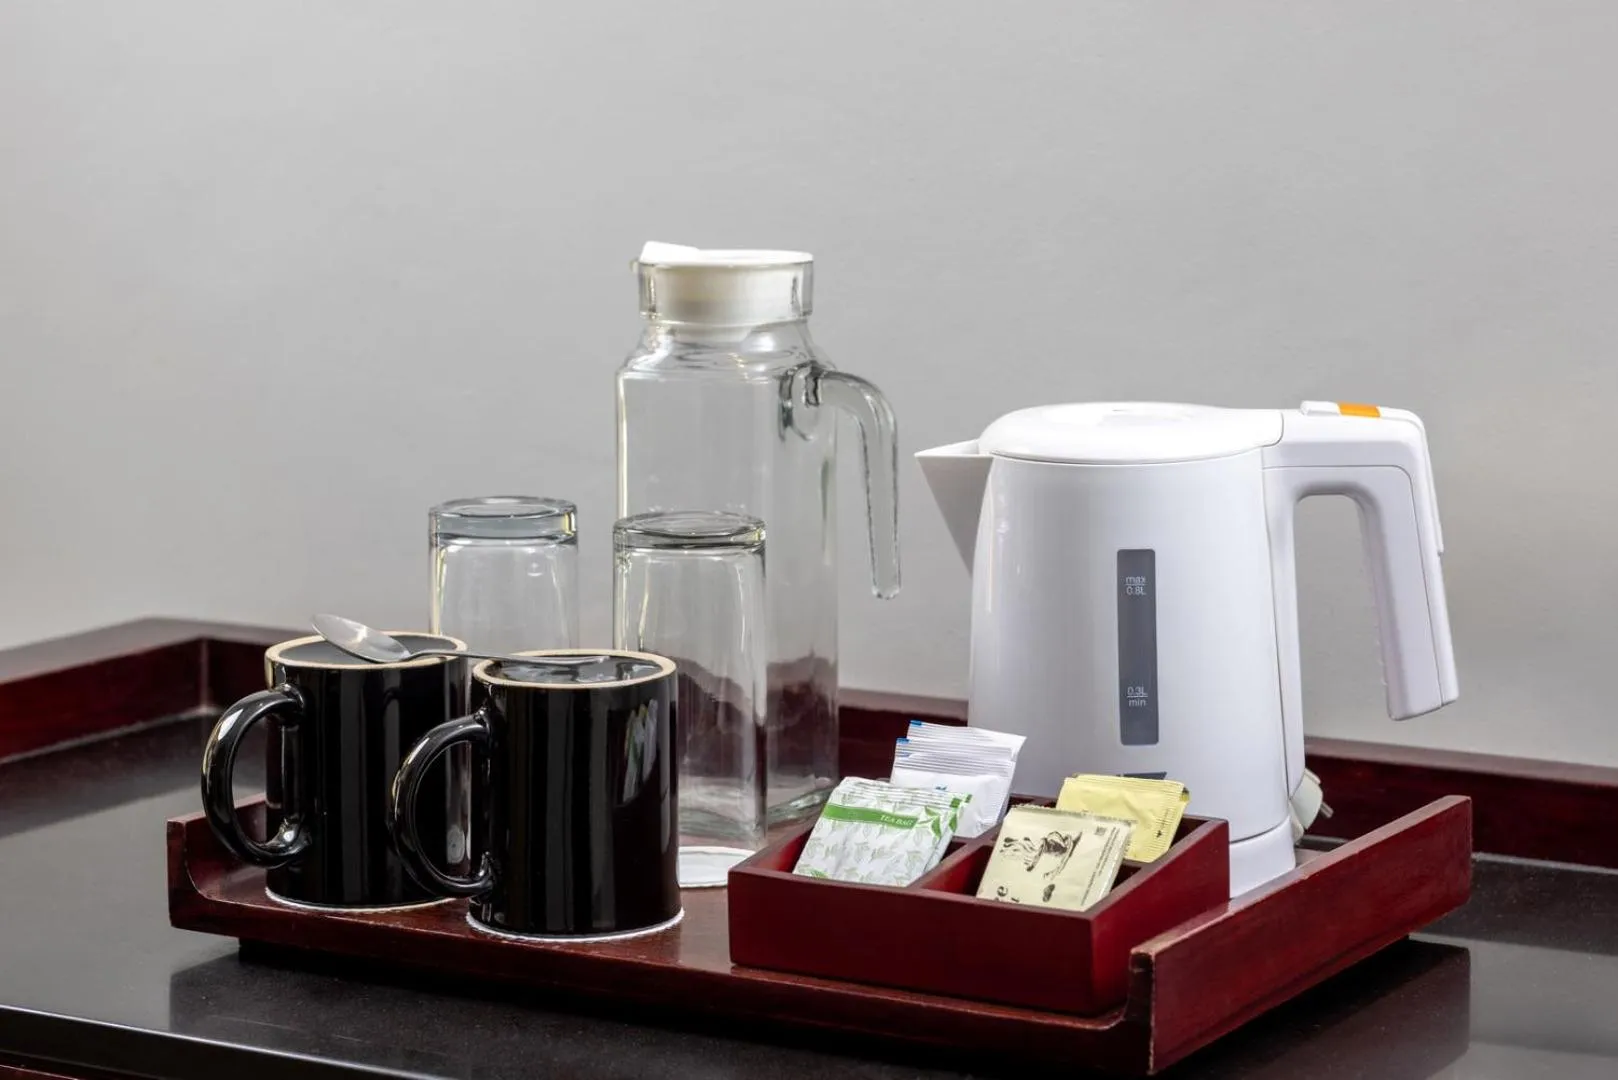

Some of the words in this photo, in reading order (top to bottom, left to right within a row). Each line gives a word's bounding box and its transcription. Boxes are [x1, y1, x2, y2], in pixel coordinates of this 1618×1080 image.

[1126, 576, 1146, 584] max
[1126, 586, 1147, 596] 0.8L
[1127, 686, 1148, 696] 0.3L
[1128, 697, 1146, 707] min
